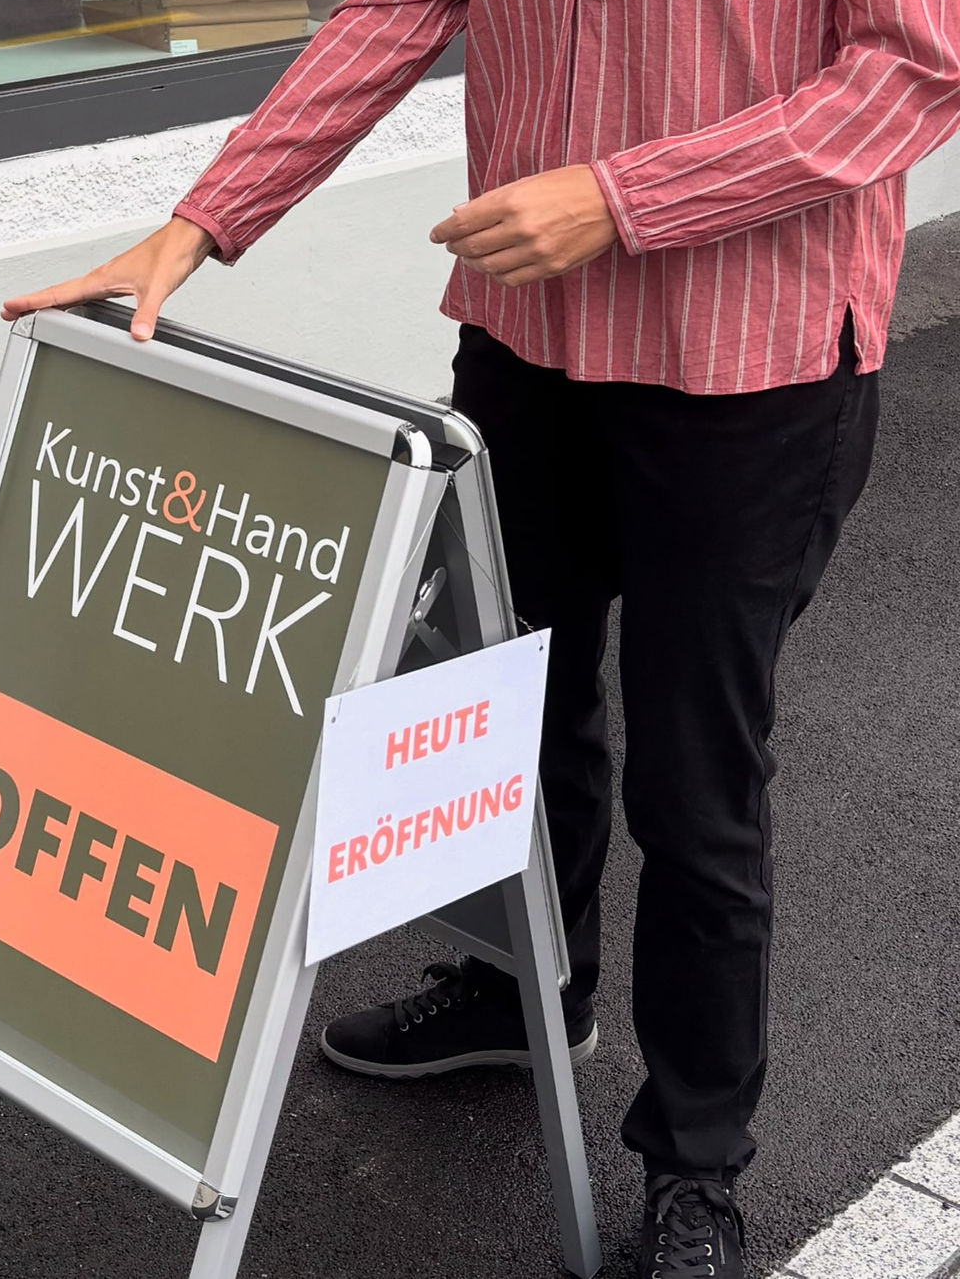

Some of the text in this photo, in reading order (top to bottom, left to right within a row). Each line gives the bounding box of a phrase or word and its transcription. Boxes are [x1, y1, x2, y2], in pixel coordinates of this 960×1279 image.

[34, 421, 351, 584] Kunst&Hand
[26, 478, 332, 717] WERK
[384, 700, 491, 770] HEUTE
[327, 774, 524, 884] ERÖFFNUNG
